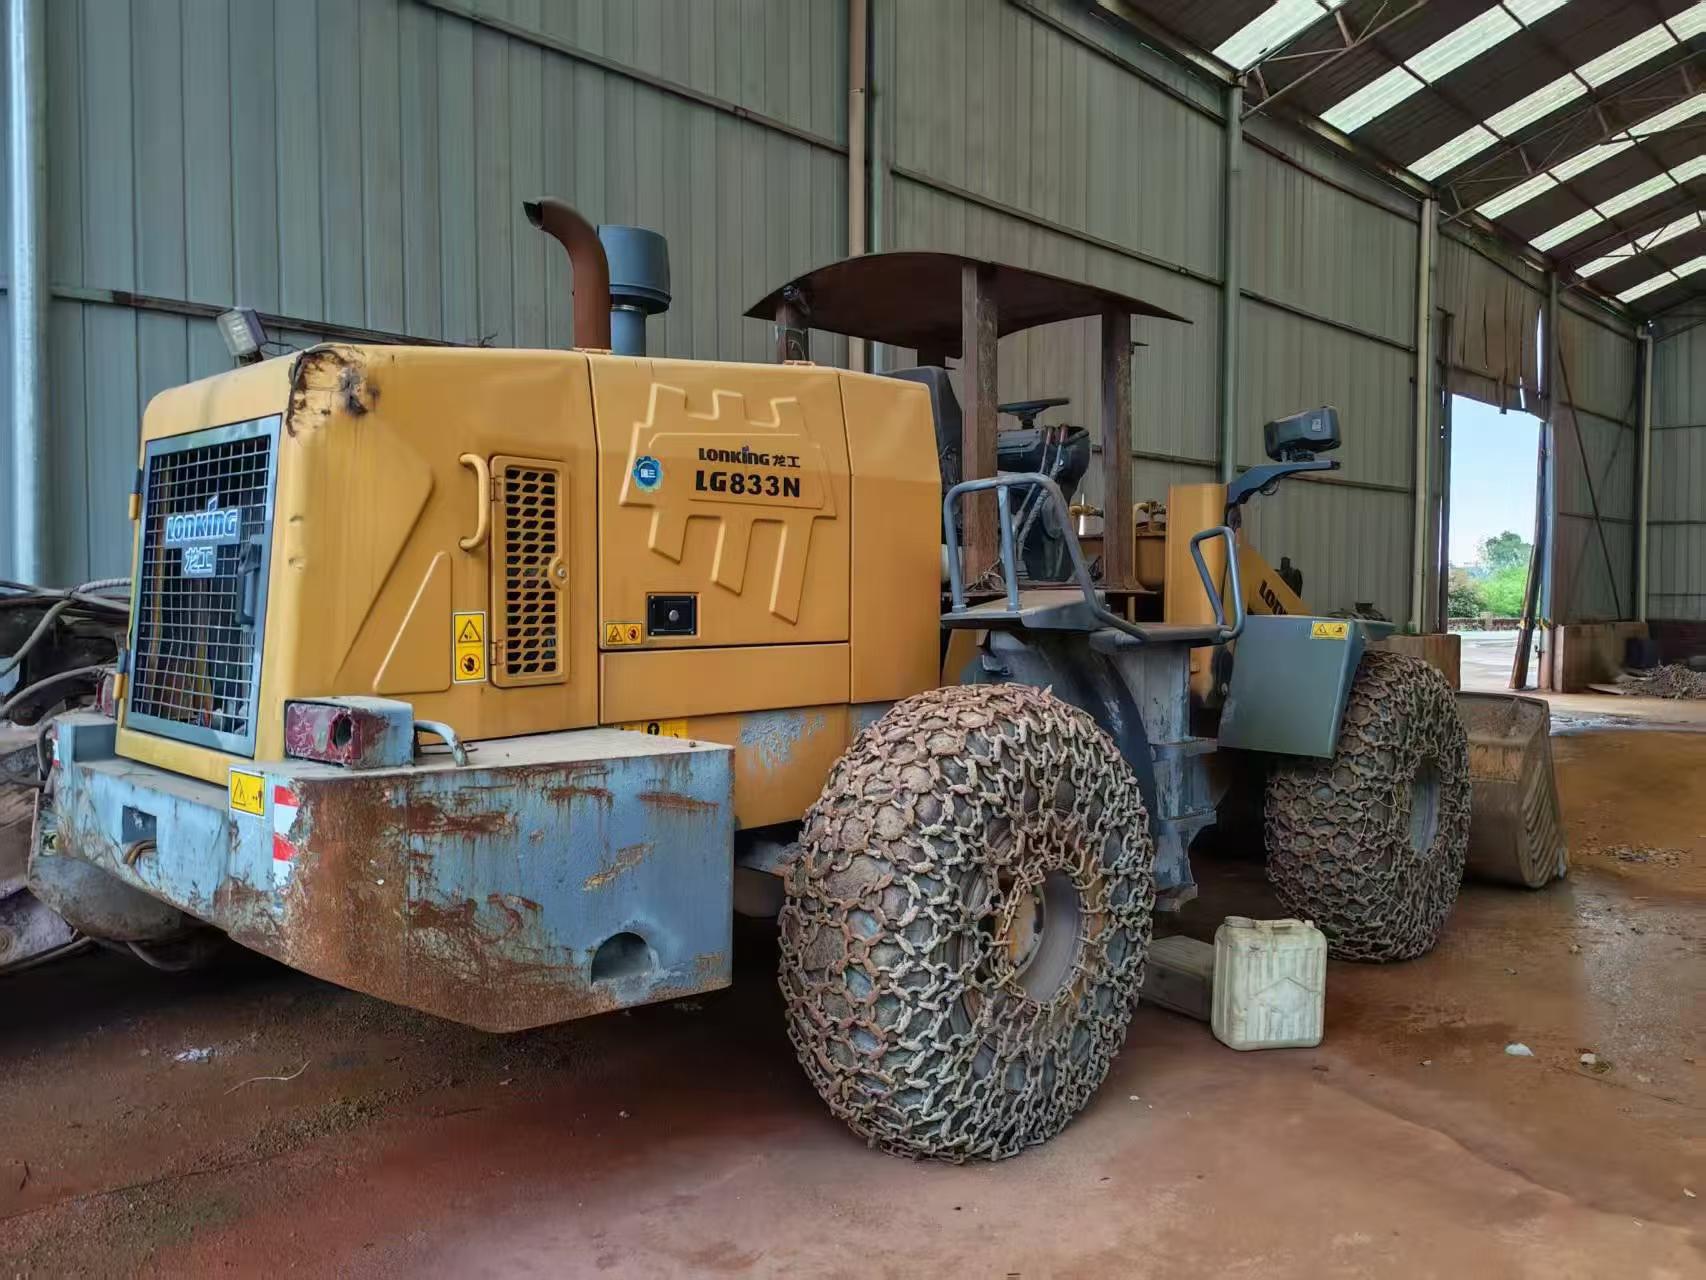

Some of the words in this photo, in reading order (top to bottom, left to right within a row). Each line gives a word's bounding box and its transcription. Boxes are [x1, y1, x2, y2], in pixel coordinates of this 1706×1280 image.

[772, 454, 800, 468] 龙工
[695, 470, 800, 498] LG833N
[184, 546, 213, 574] 龙工
